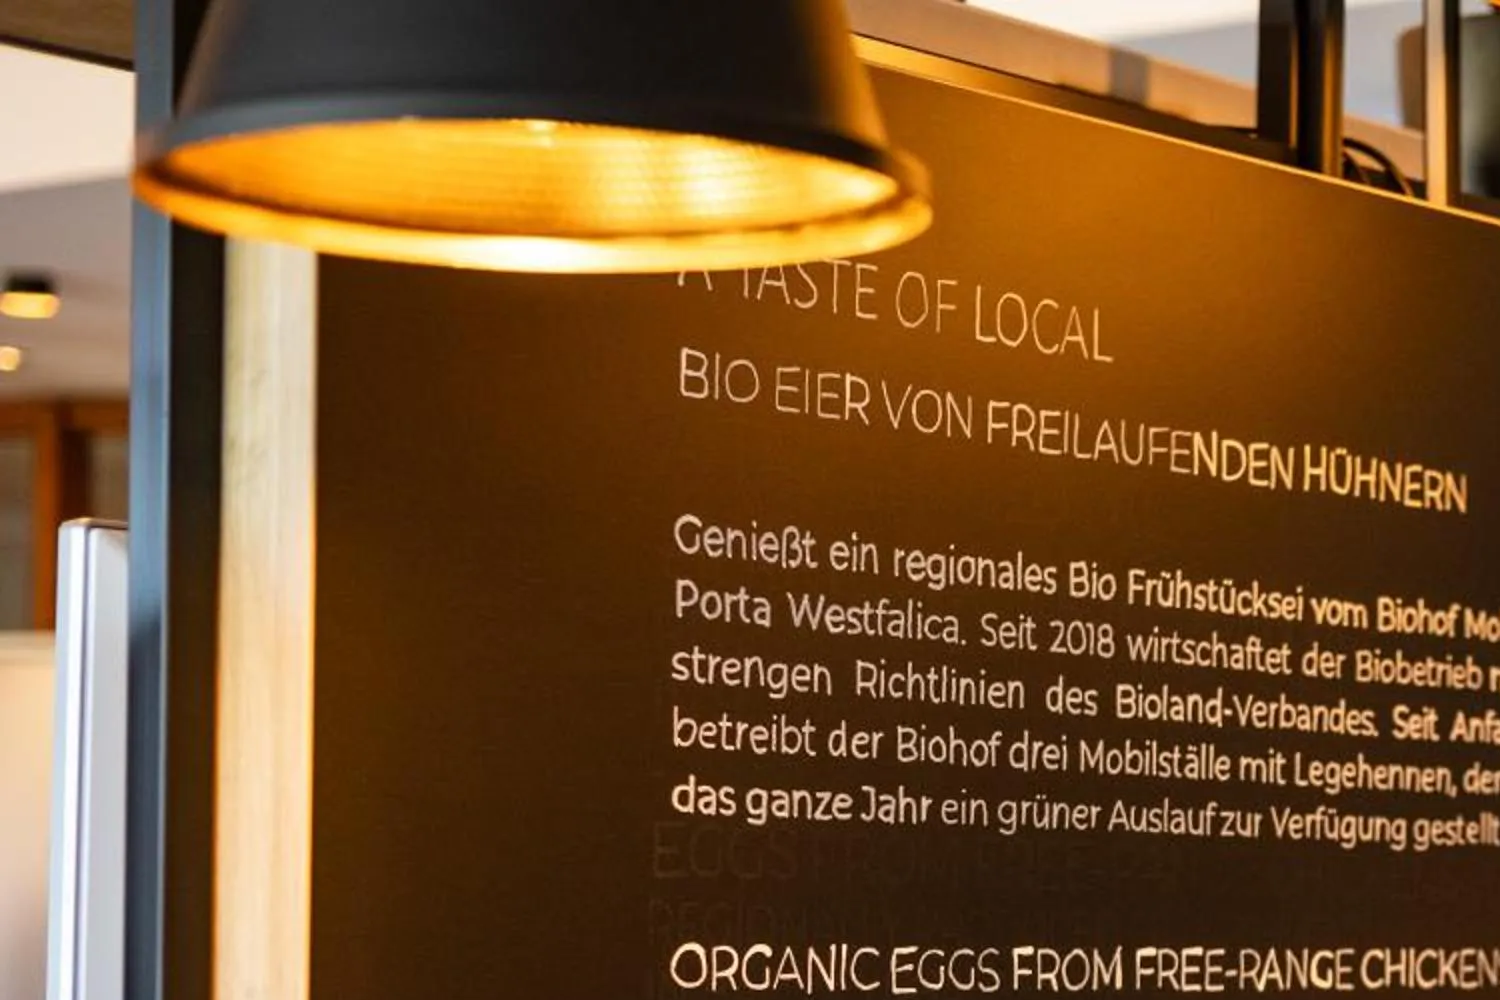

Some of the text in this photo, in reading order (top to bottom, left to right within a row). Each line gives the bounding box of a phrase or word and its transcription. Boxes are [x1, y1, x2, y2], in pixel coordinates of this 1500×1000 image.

[896, 272, 957, 332] OF
[975, 285, 1113, 362] LOCAL
[680, 347, 1467, 513] BIO EIER VON FREILAUFENDEN HÜHNERN
[674, 514, 818, 569] Genießt
[829, 532, 879, 575] ein
[894, 544, 1057, 595] regionales
[1069, 560, 1117, 601] Bio
[1128, 568, 1304, 621] Frühstücksei
[1309, 597, 1368, 629] vom
[1377, 596, 1462, 638] Biohof
[676, 578, 771, 628] Porta
[786, 592, 966, 645] Westfalica.
[980, 612, 1038, 651] Seit
[1049, 620, 1115, 659] 2018
[1126, 626, 1292, 675] wirtschaftet
[1301, 641, 1347, 679] der
[1355, 648, 1484, 690] Biobetrieb
[671, 645, 832, 699] strengen
[856, 658, 1024, 709] Richtlinien
[1046, 674, 1098, 716] des
[1116, 683, 1379, 737] Bioland-Verbandes.
[1392, 704, 1440, 742] Seit
[673, 705, 816, 757] betreibt
[828, 720, 884, 759] der
[896, 724, 1003, 767] Biohof
[1009, 730, 1068, 772] drei
[1079, 739, 1231, 781] Mobilställe
[1239, 748, 1287, 786] mit
[1294, 752, 1457, 798] Legehennen,
[671, 774, 736, 816] das
[745, 788, 853, 826] ganze
[860, 785, 933, 825] Jahr
[941, 788, 988, 826] ein
[997, 794, 1102, 835] grüner
[1107, 797, 1218, 836] Auslauf
[1220, 810, 1263, 838] zur
[1270, 805, 1407, 852] Verfügung
[670, 941, 880, 995] ORGANIC
[890, 946, 1000, 995] EGGS
[1012, 945, 1123, 992] FROM
[1135, 946, 1355, 992] FREE-RANGE
